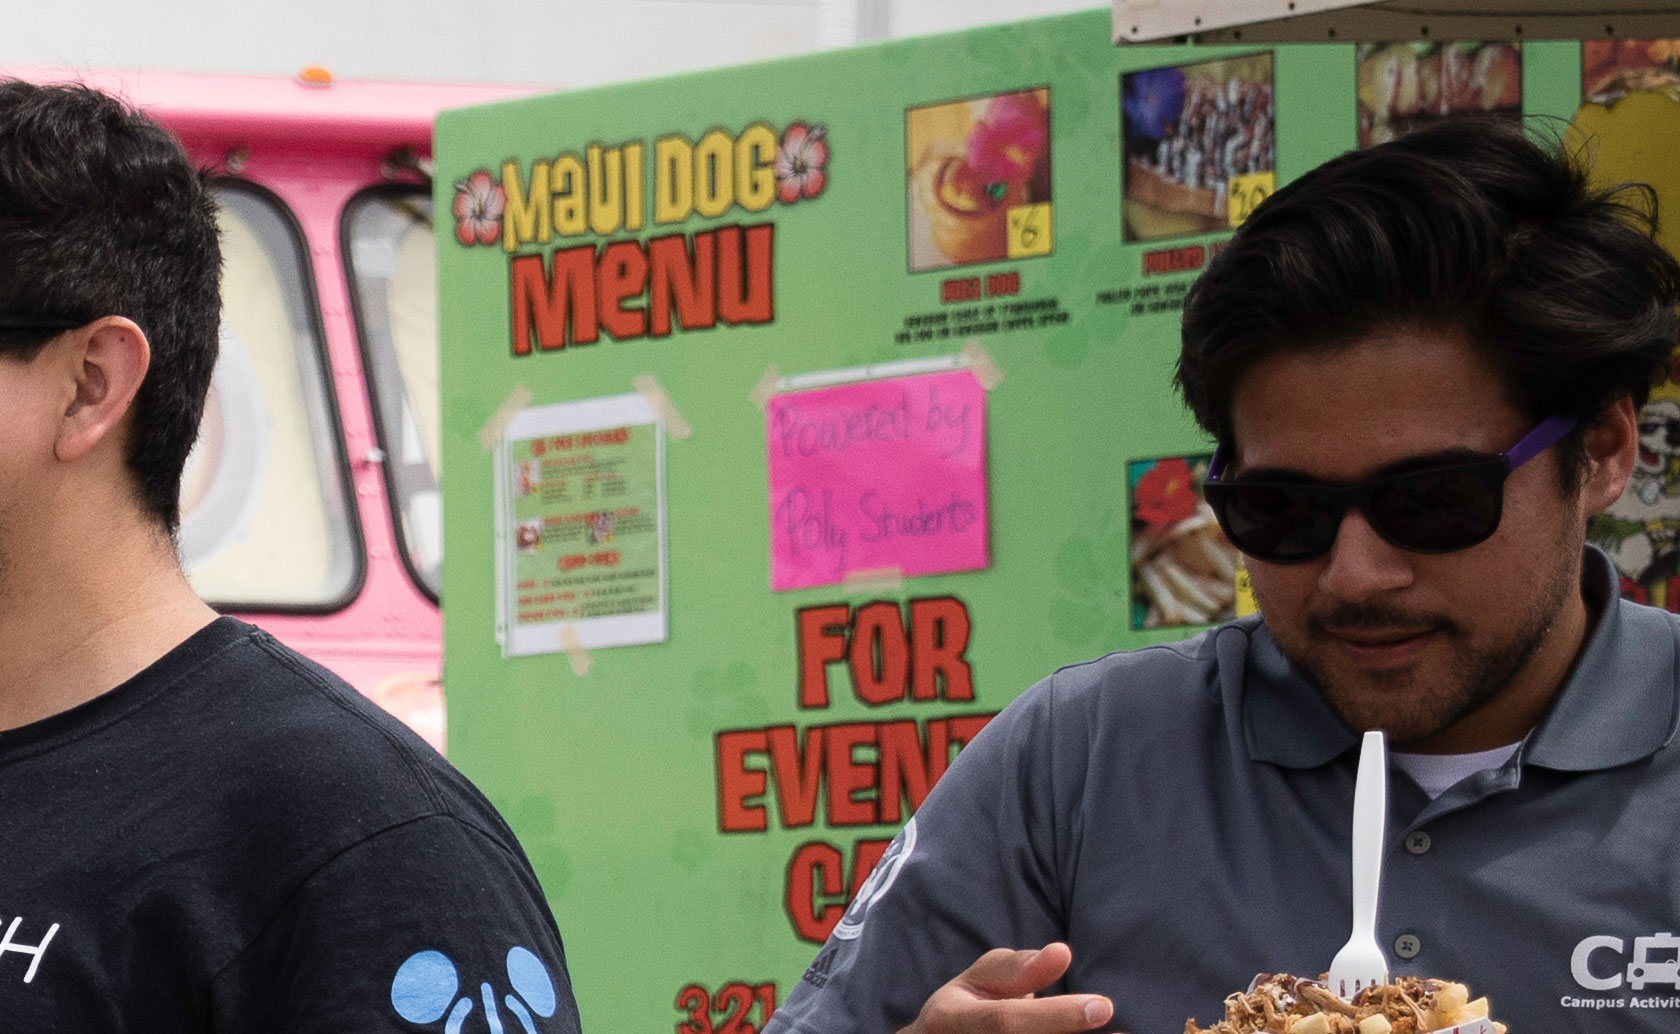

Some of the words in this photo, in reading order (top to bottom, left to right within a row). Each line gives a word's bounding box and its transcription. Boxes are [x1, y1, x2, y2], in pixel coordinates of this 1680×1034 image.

[654, 122, 780, 224] DOG
[926, 384, 968, 459] by
[860, 489, 977, 543] Students
[797, 594, 976, 710] FOR
[1560, 995, 1625, 1010] Campus
